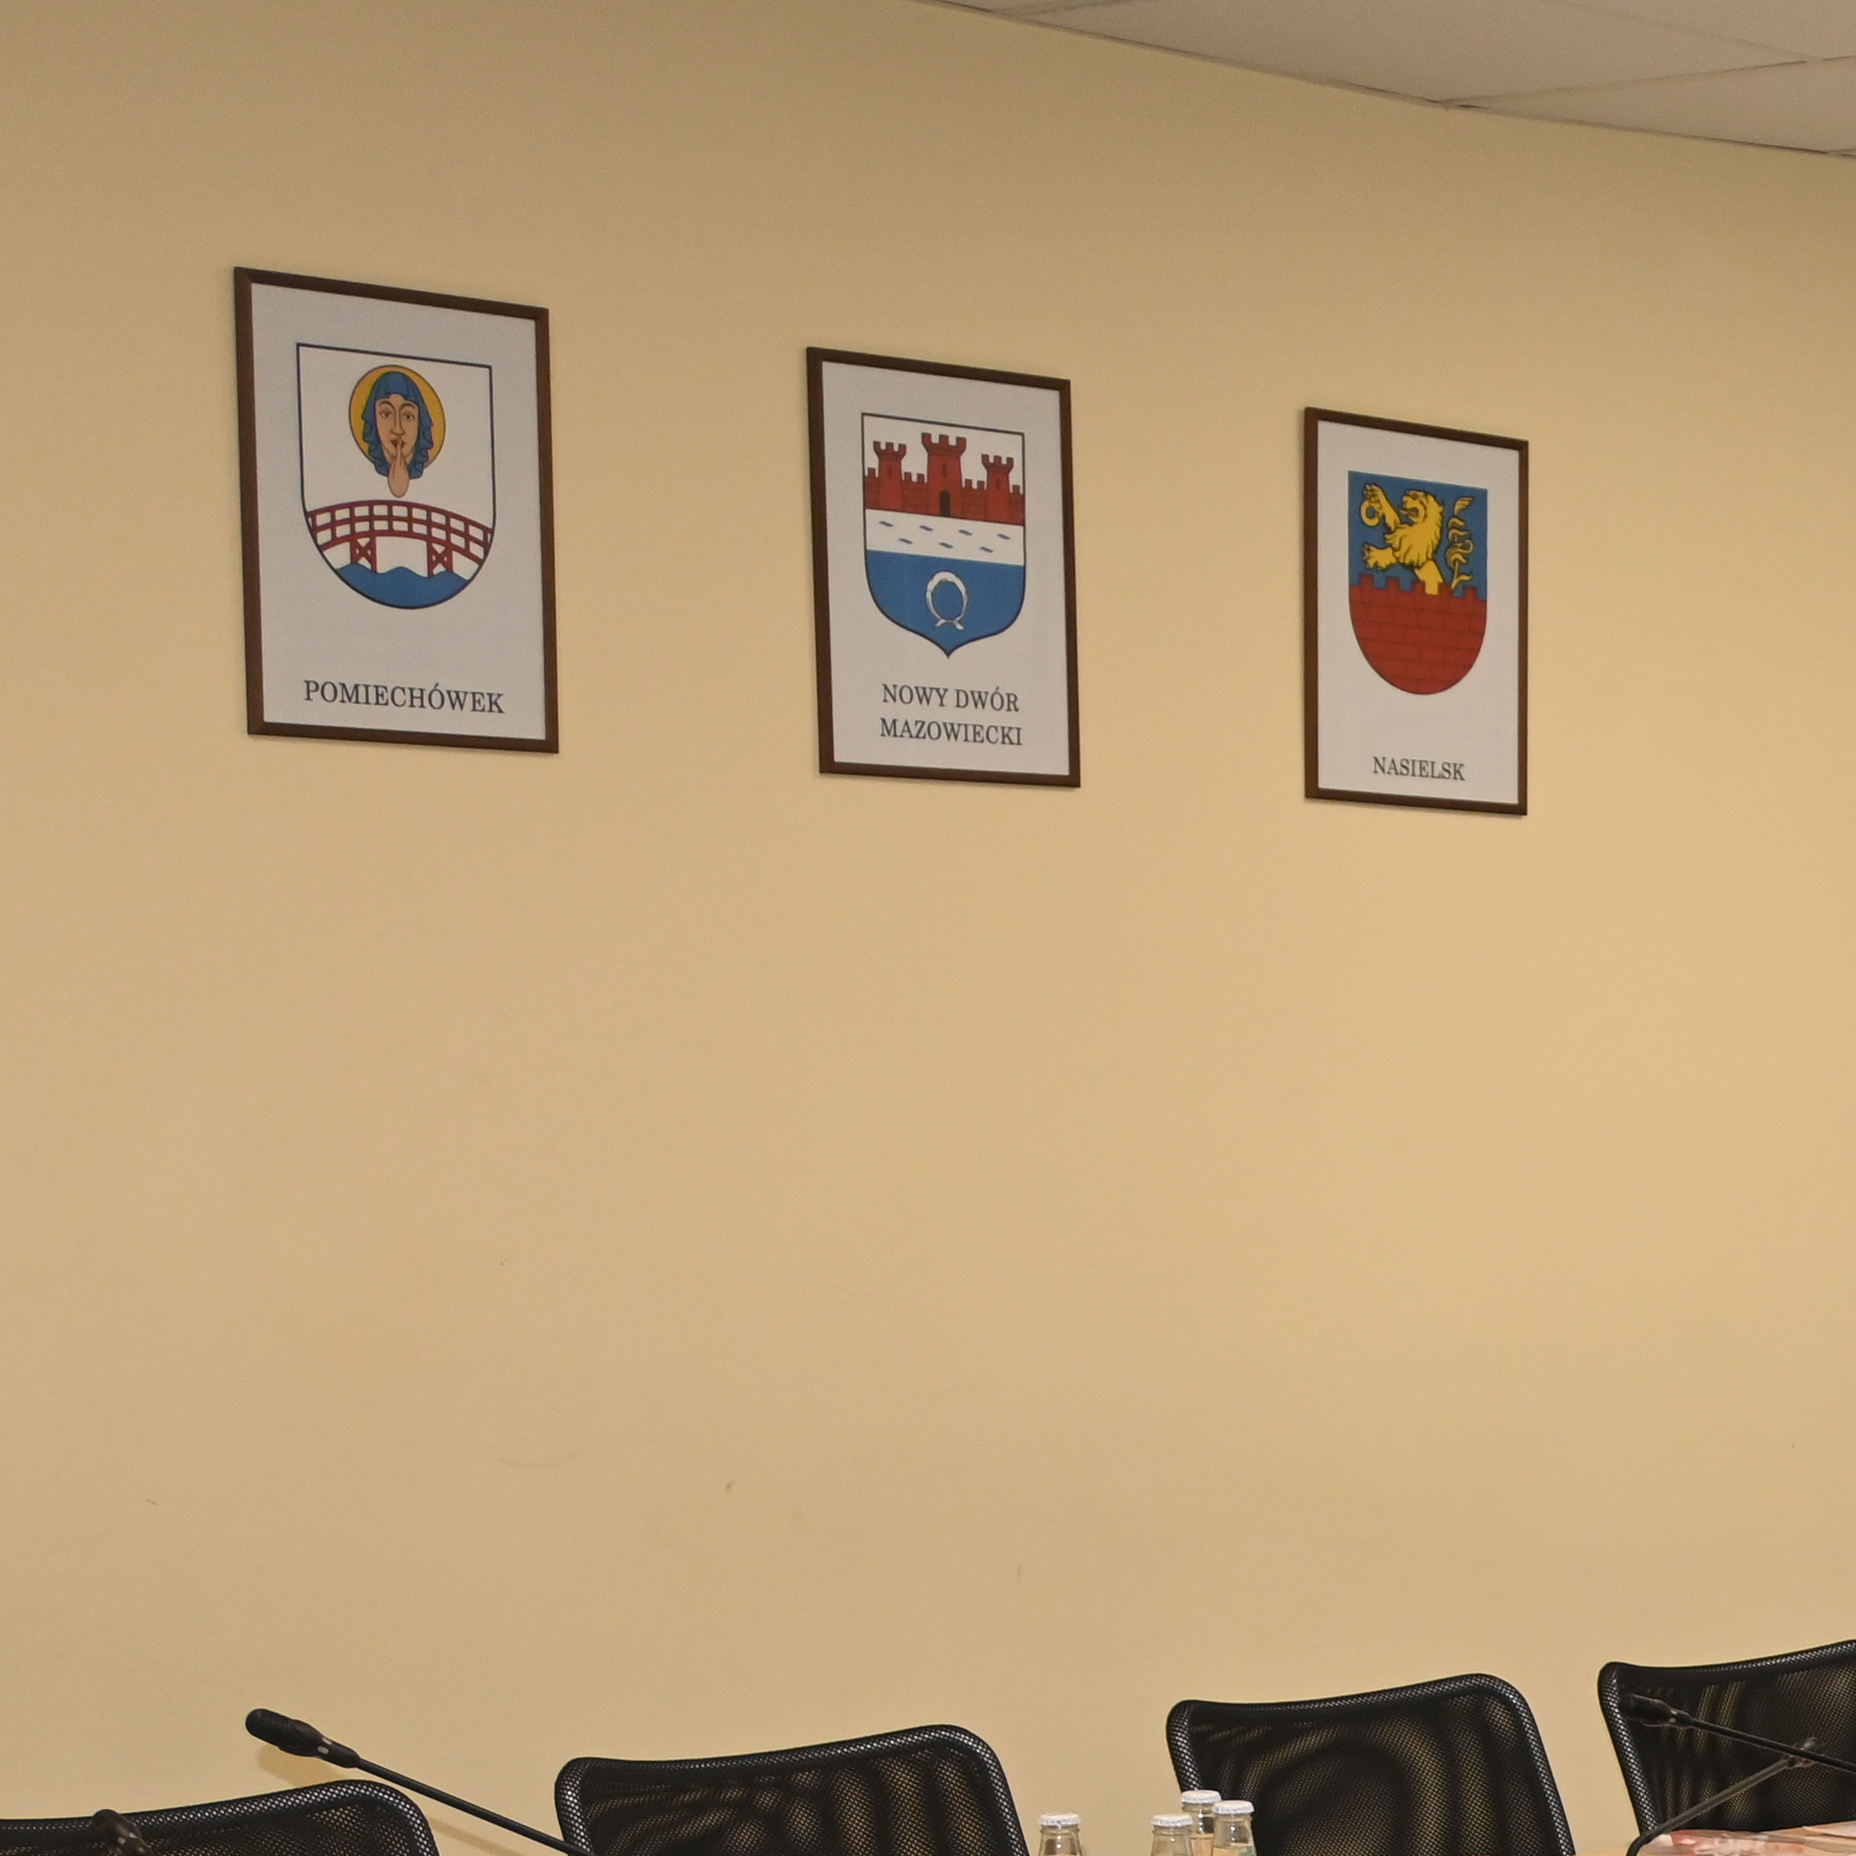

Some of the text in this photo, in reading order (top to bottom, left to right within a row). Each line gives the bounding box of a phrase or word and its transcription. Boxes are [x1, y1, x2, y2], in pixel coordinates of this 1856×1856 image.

[303, 679, 506, 715] POMIECHÓWEK
[881, 683, 1020, 713] NOWY DWÓR
[879, 717, 1023, 746] MAZOWIECKI
[1372, 756, 1466, 782] NASIELSK
